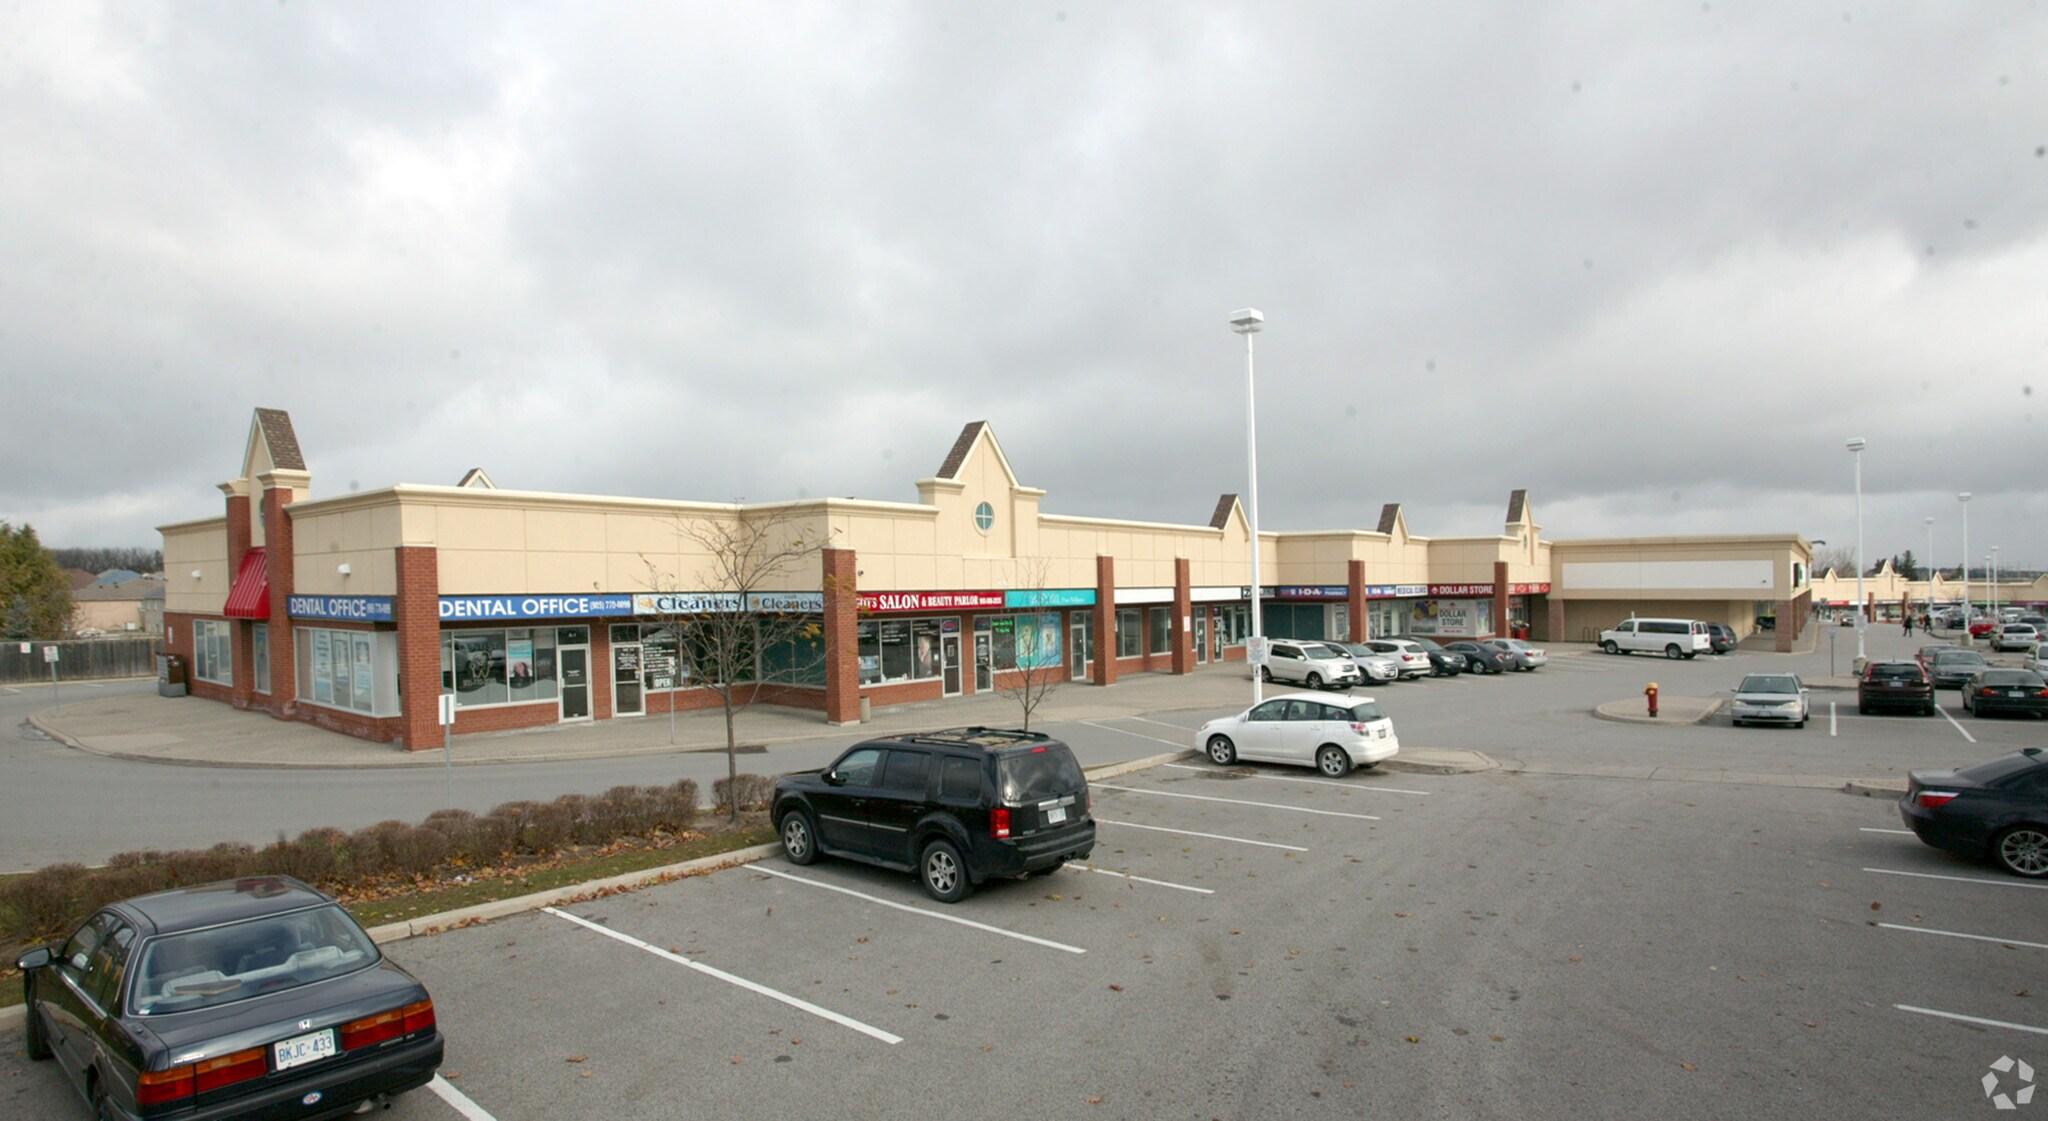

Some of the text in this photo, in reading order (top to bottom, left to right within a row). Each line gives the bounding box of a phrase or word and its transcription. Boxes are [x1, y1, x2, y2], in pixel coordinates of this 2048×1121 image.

[1440, 585, 1494, 595] DOLLAR STORE
[290, 597, 327, 615] DENTAL
[328, 598, 367, 617] OFFICE
[439, 599, 517, 617] DENTAL
[521, 597, 589, 615] OFFICE
[656, 596, 741, 611] Cleaners
[761, 597, 822, 610] Cleaners
[879, 594, 919, 609] SALON
[921, 598, 927, 607] &
[927, 596, 953, 607] BEAUTY
[953, 595, 979, 606] PARLOR
[1439, 610, 1467, 618] DOLLAR
[1442, 618, 1464, 626] STORE
[655, 678, 671, 688] OPEN
